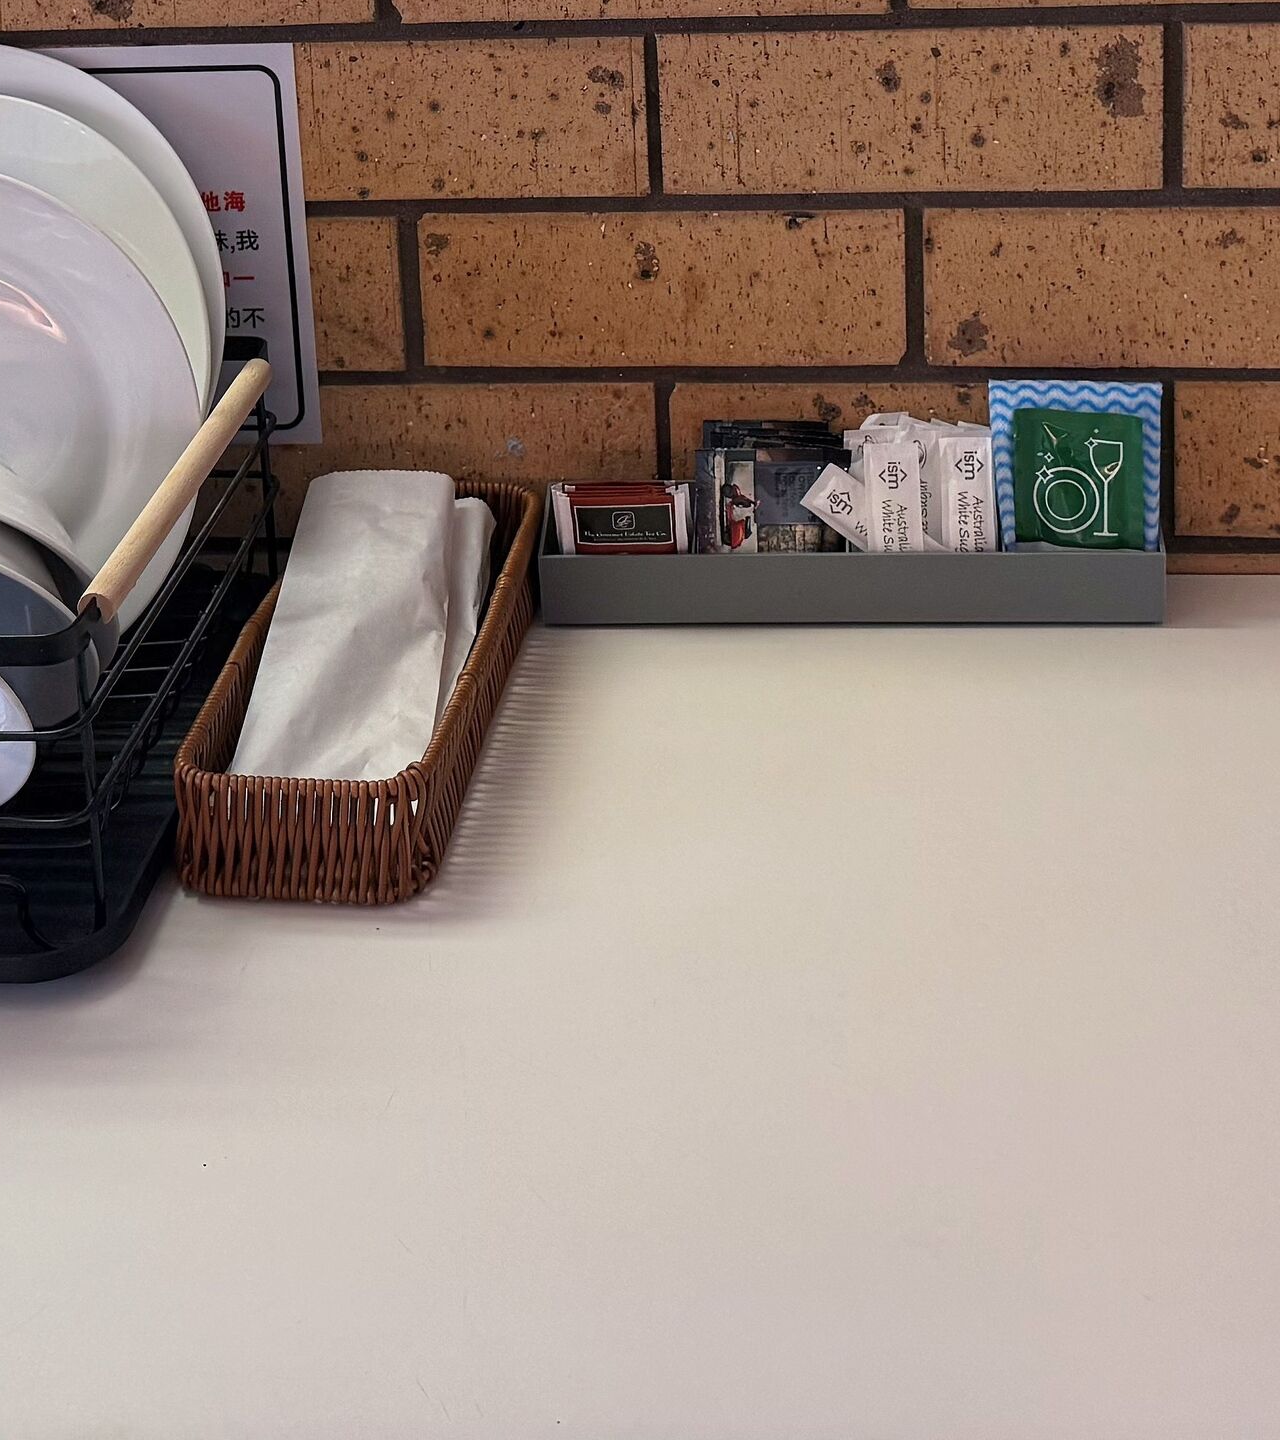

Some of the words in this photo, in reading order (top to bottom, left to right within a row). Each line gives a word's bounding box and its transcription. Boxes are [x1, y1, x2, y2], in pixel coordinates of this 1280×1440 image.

[887, 461, 901, 490] ism
[963, 450, 978, 481] ism
[826, 489, 853, 515] ism
[881, 499, 896, 533] White
[957, 491, 972, 525] White
